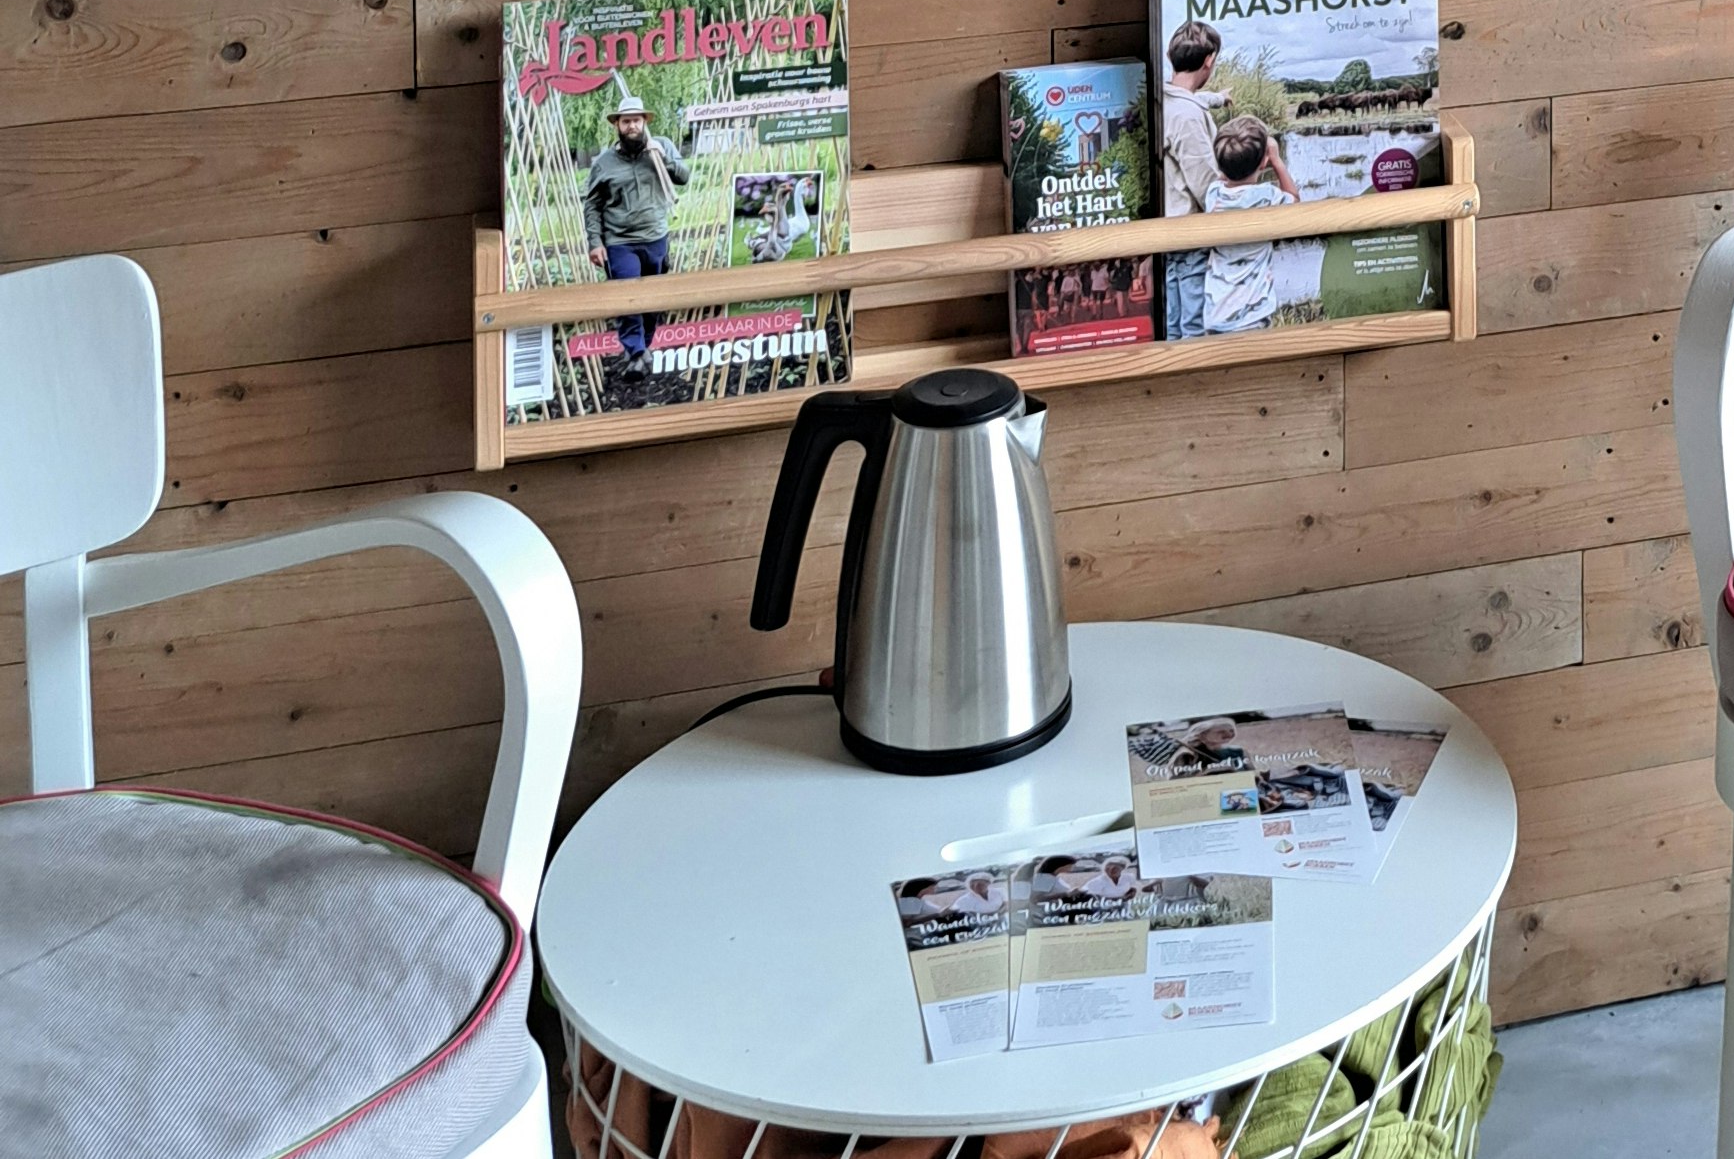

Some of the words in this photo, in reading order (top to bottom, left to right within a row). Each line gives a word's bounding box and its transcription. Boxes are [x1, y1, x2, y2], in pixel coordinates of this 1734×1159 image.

[1326, 15, 1360, 34] Streek
[1362, 20, 1377, 31] om
[1379, 18, 1391, 30] te
[520, 7, 832, 81] Landleven
[739, 70, 783, 82] Inspiratie
[784, 69, 805, 77] voor
[1068, 83, 1093, 95] UDEN
[1068, 90, 1111, 104] CENTRUM
[694, 105, 726, 116] Geheim
[728, 103, 749, 112] van
[751, 96, 815, 111] Spakenburgs
[815, 94, 832, 104] hart
[808, 116, 832, 127] verse
[765, 127, 796, 140] groene
[798, 125, 832, 135] kruiden
[1378, 159, 1412, 170] GRATIS
[1041, 167, 1119, 196] Ontdek
[1037, 195, 1073, 219] het
[1076, 191, 1125, 214] Hart
[1031, 218, 1072, 234] van
[1075, 213, 1131, 232] Uden
[576, 335, 620, 352] ALLES
[655, 326, 696, 344] VOOR
[699, 319, 755, 338] ELKAAR
[757, 317, 772, 330] IN
[775, 314, 793, 329] DE
[652, 323, 828, 374] moestuin
[1146, 763, 1171, 780] Op
[1174, 761, 1202, 780] pad
[1207, 756, 1233, 772] met
[1234, 755, 1250, 770] je
[1255, 747, 1321, 764] knapzak
[1037, 897, 1123, 914] Wandelen
[1127, 895, 1158, 909] met
[1042, 913, 1071, 925] een
[1136, 903, 1159, 917] vol
[1162, 900, 1218, 916] lekkers
[911, 909, 1000, 933] Wandelen
[921, 933, 953, 947] een
